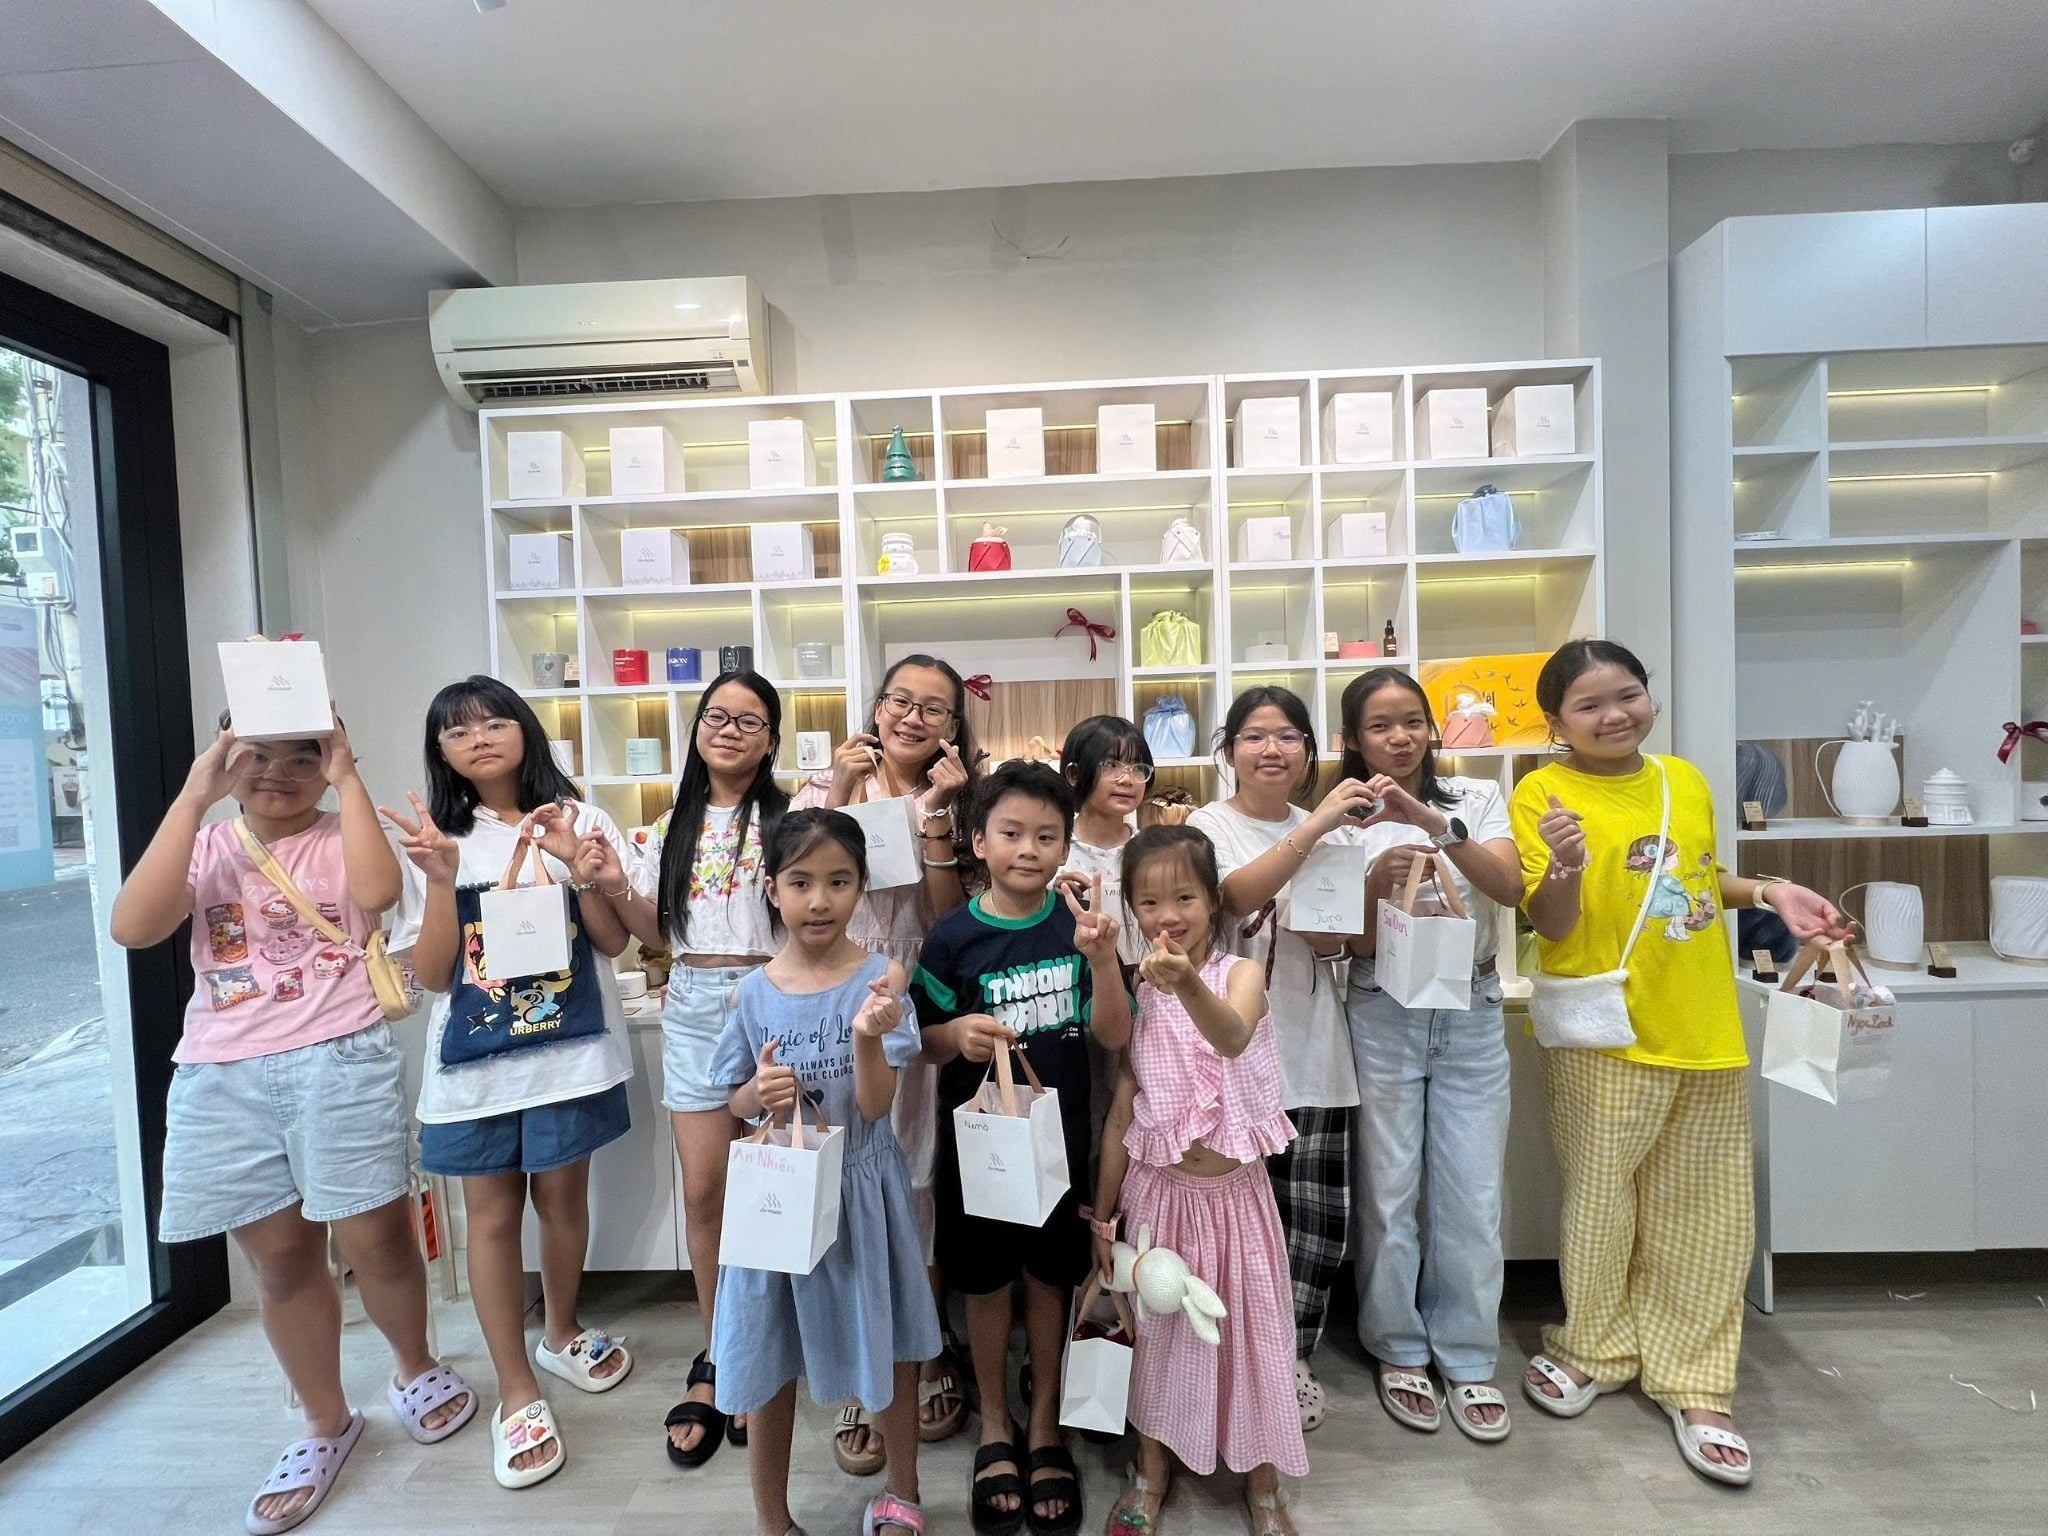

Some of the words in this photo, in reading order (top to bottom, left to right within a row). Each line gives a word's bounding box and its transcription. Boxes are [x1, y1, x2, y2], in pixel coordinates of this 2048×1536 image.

[984, 958, 1076, 1004] THROW
[809, 1017, 830, 1053] of
[799, 1057, 836, 1071] ALWAYS
[801, 1071, 818, 1082] THE
